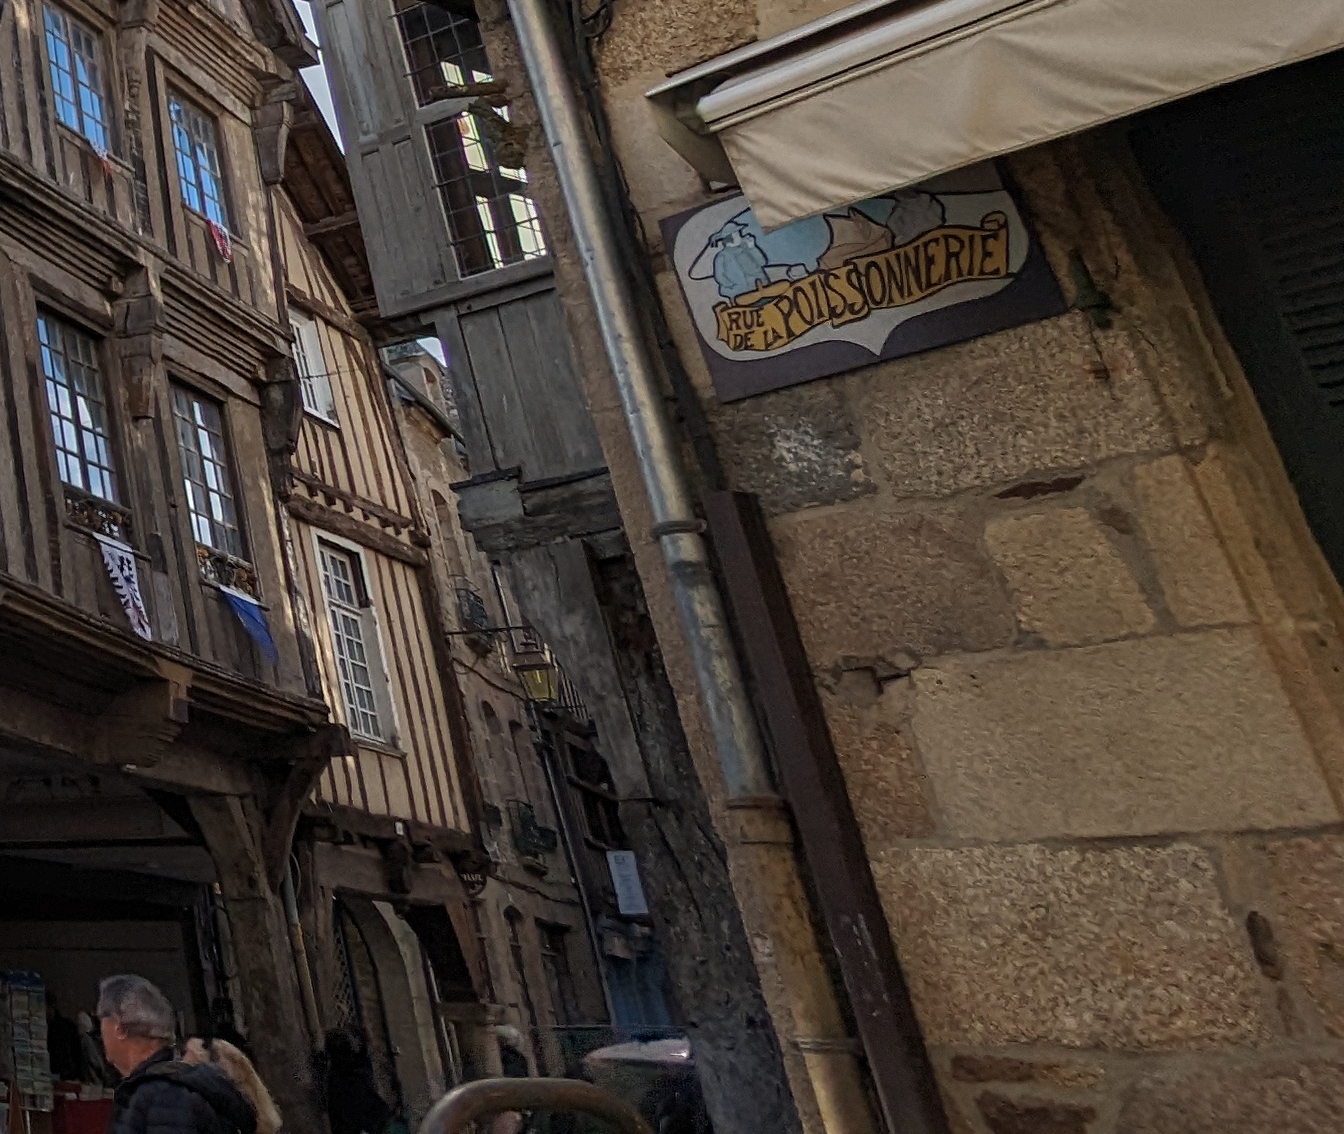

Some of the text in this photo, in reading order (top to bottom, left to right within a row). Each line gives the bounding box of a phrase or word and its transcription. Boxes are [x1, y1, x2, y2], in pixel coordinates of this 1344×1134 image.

[774, 232, 1001, 330] POISSONNERIE
[726, 309, 765, 330] RUE
[732, 328, 783, 351] DE LA
